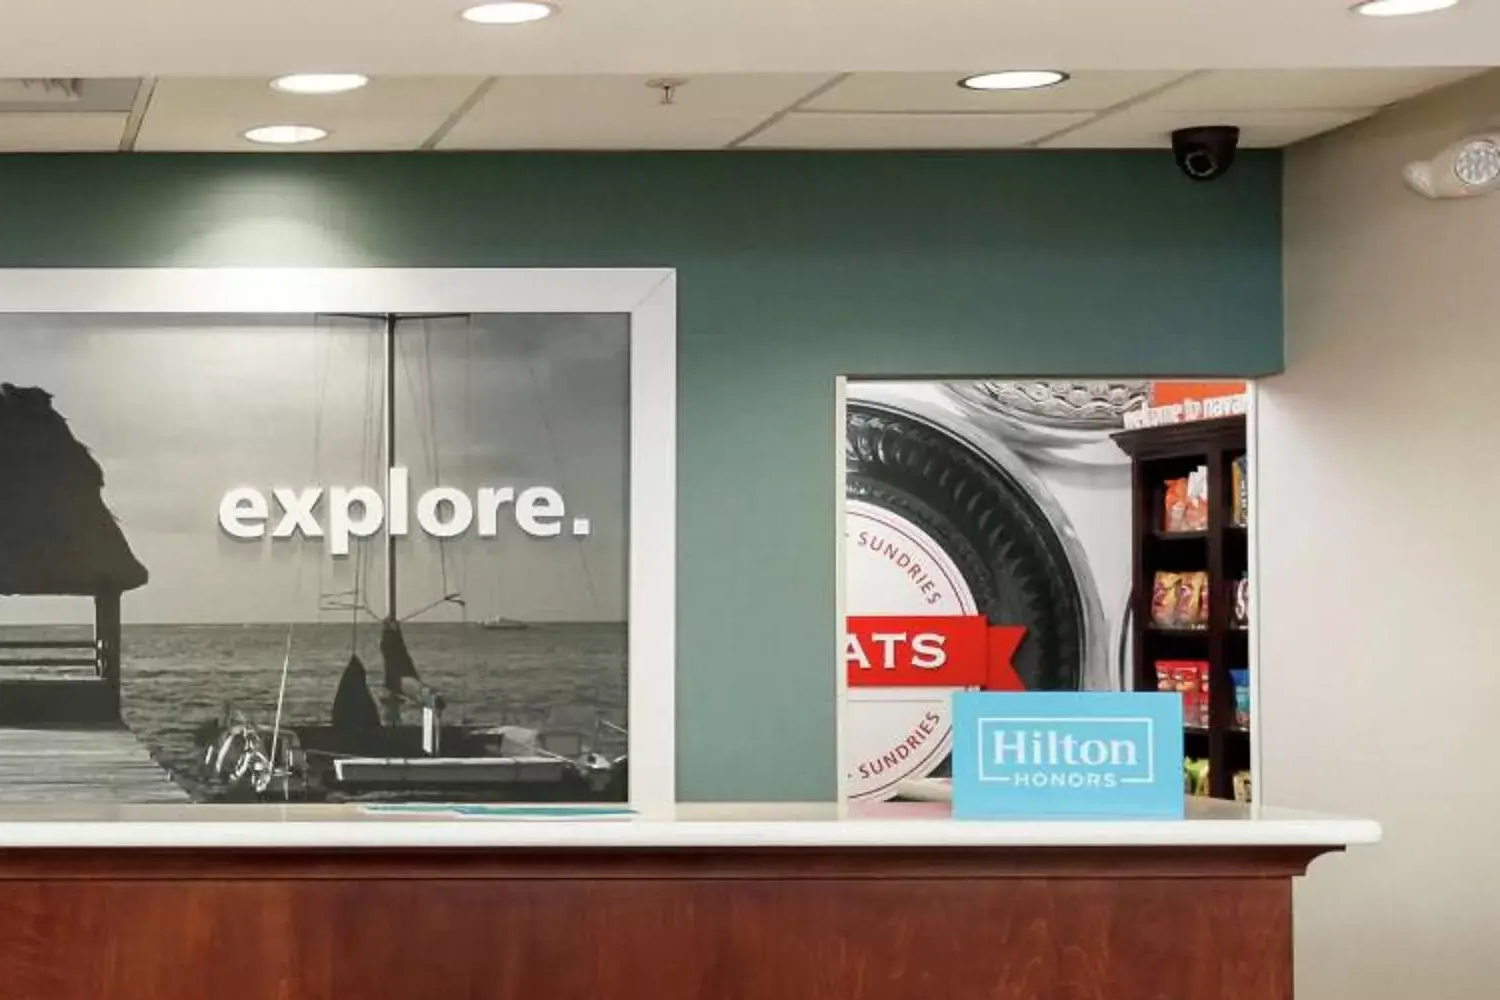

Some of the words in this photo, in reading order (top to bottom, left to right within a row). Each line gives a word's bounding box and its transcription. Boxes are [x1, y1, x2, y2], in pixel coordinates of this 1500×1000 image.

[218, 466, 591, 556] explore.
[857, 530, 943, 605] SUNDRIES
[846, 631, 948, 669] ATS
[858, 710, 941, 780] SUNDRIES
[993, 729, 1138, 766] Hilton
[1013, 772, 1118, 788] HONORS
